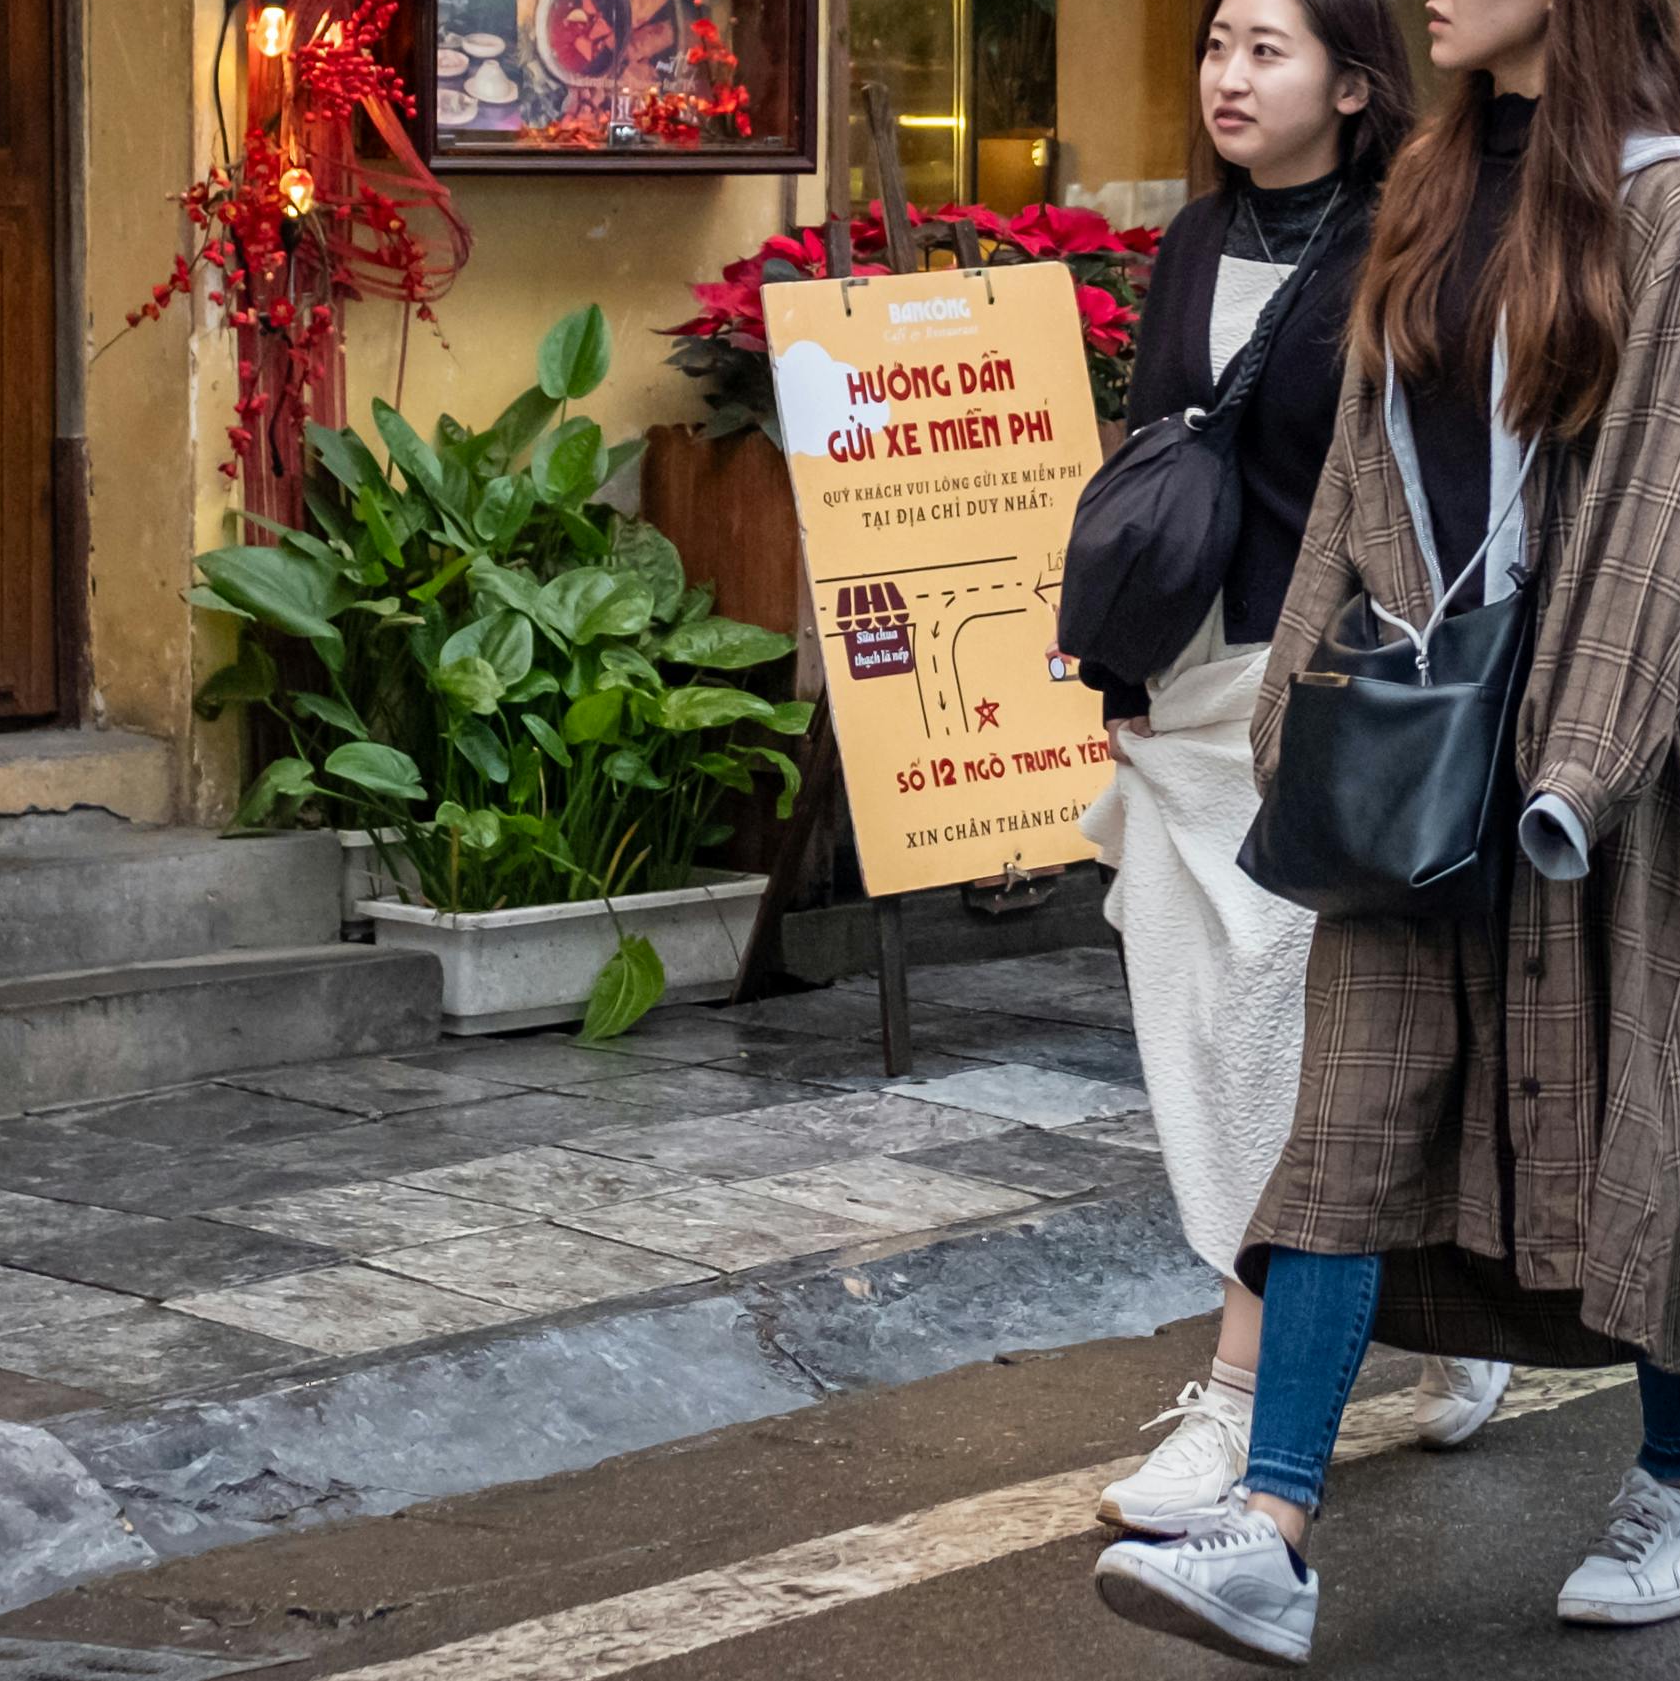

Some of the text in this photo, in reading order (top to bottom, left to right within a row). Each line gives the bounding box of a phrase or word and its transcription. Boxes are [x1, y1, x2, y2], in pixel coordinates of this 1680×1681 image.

[846, 349, 1016, 406] HƯỚNG DẪN
[827, 397, 1054, 464] GỬI XE MIỄN PHÍ
[823, 486, 851, 508] QUÝ
[855, 483, 903, 502] KHÁCH
[907, 480, 930, 496] VUI
[934, 475, 970, 493] LÒNG
[1001, 470, 1018, 486] XE
[1060, 461, 1083, 480] PHÍ
[861, 509, 891, 532] TẠI
[897, 506, 927, 528] ĐỊA
[966, 497, 999, 517] DUY
[896, 757, 926, 794] SỐ
[930, 757, 958, 787] 12
[963, 752, 1006, 783] NGÕ
[1011, 746, 1072, 775] TRUNG
[905, 829, 939, 850] XIN
[943, 817, 992, 842] CHÂN
[996, 809, 1056, 834] THÀNH
